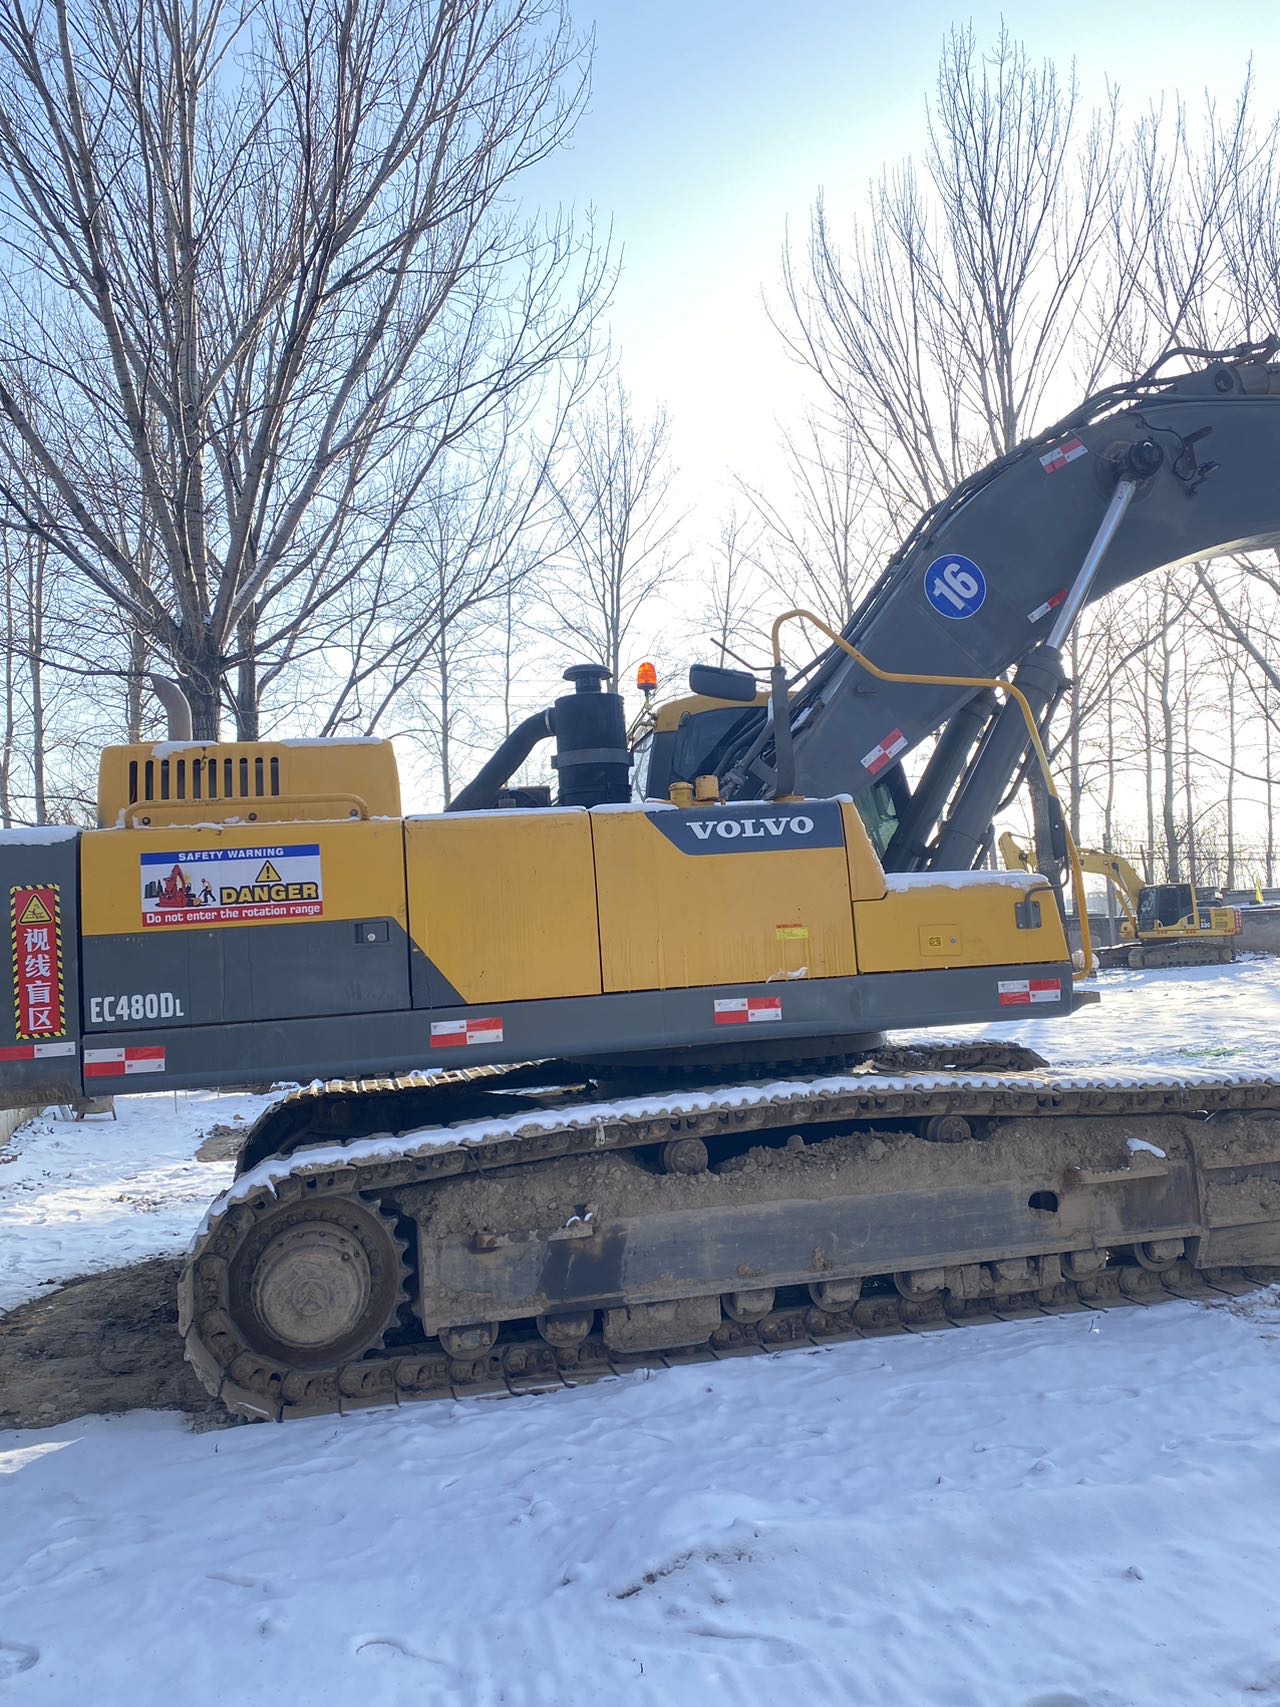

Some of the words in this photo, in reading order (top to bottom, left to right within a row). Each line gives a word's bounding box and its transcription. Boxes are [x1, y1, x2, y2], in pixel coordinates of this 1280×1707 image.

[933, 563, 978, 610] 16
[686, 816, 815, 840] VOLVO
[178, 851, 223, 861] SAFETY
[227, 848, 284, 858] WARNING
[220, 882, 319, 905] DANGER
[146, 913, 162, 924] Do
[165, 913, 184, 922] not
[187, 911, 217, 920] enter
[220, 908, 239, 918] the
[242, 905, 287, 917] rotation
[290, 905, 320, 915] range
[23, 928, 53, 1031] 视线盲区
[90, 992, 185, 1023] EC480DL
